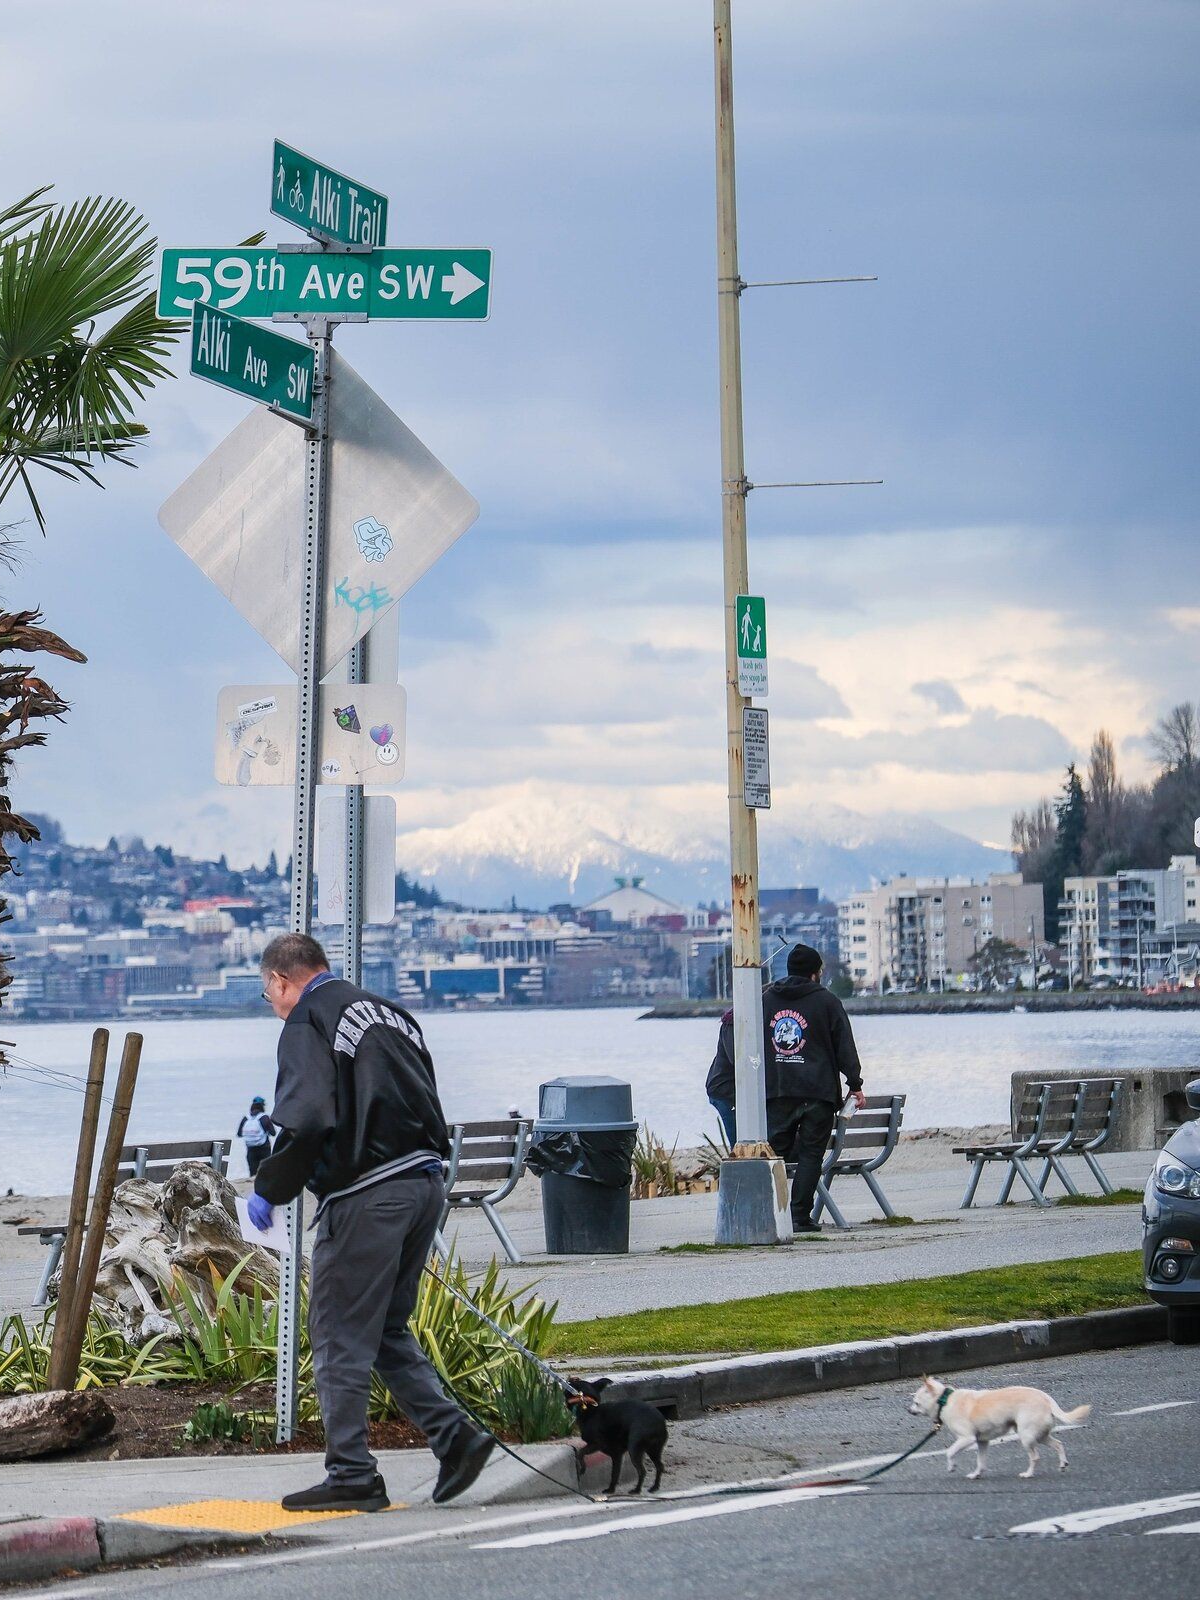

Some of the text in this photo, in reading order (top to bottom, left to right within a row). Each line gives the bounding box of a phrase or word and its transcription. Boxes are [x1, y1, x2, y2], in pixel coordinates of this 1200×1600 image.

[309, 169, 382, 246] Alki Trail
[173, 256, 435, 310] 59th Ave SW
[197, 310, 309, 404] Alki Ave SW
[333, 1000, 423, 1058] WHITE SOX
